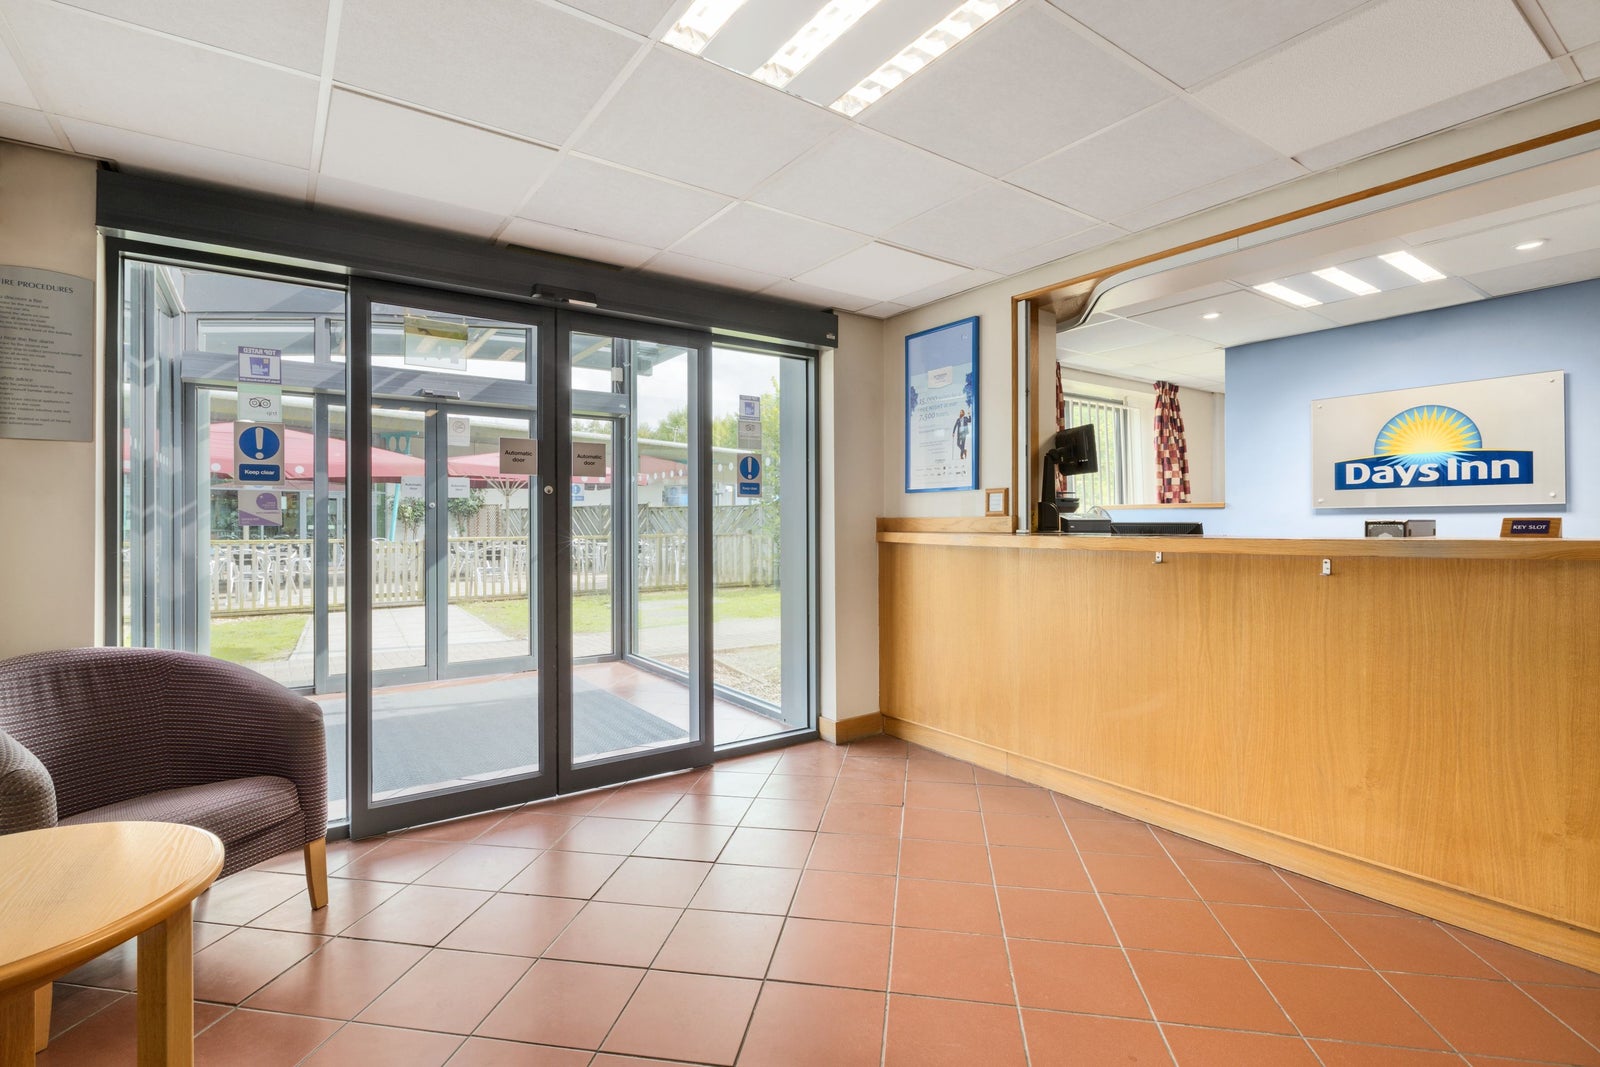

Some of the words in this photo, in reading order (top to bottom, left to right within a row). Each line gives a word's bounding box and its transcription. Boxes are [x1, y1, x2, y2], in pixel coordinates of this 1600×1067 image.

[0, 277, 15, 286] IRE
[17, 280, 74, 294] PROCEDURES
[1345, 462, 1440, 486] Days
[1447, 458, 1520, 481] Inn
